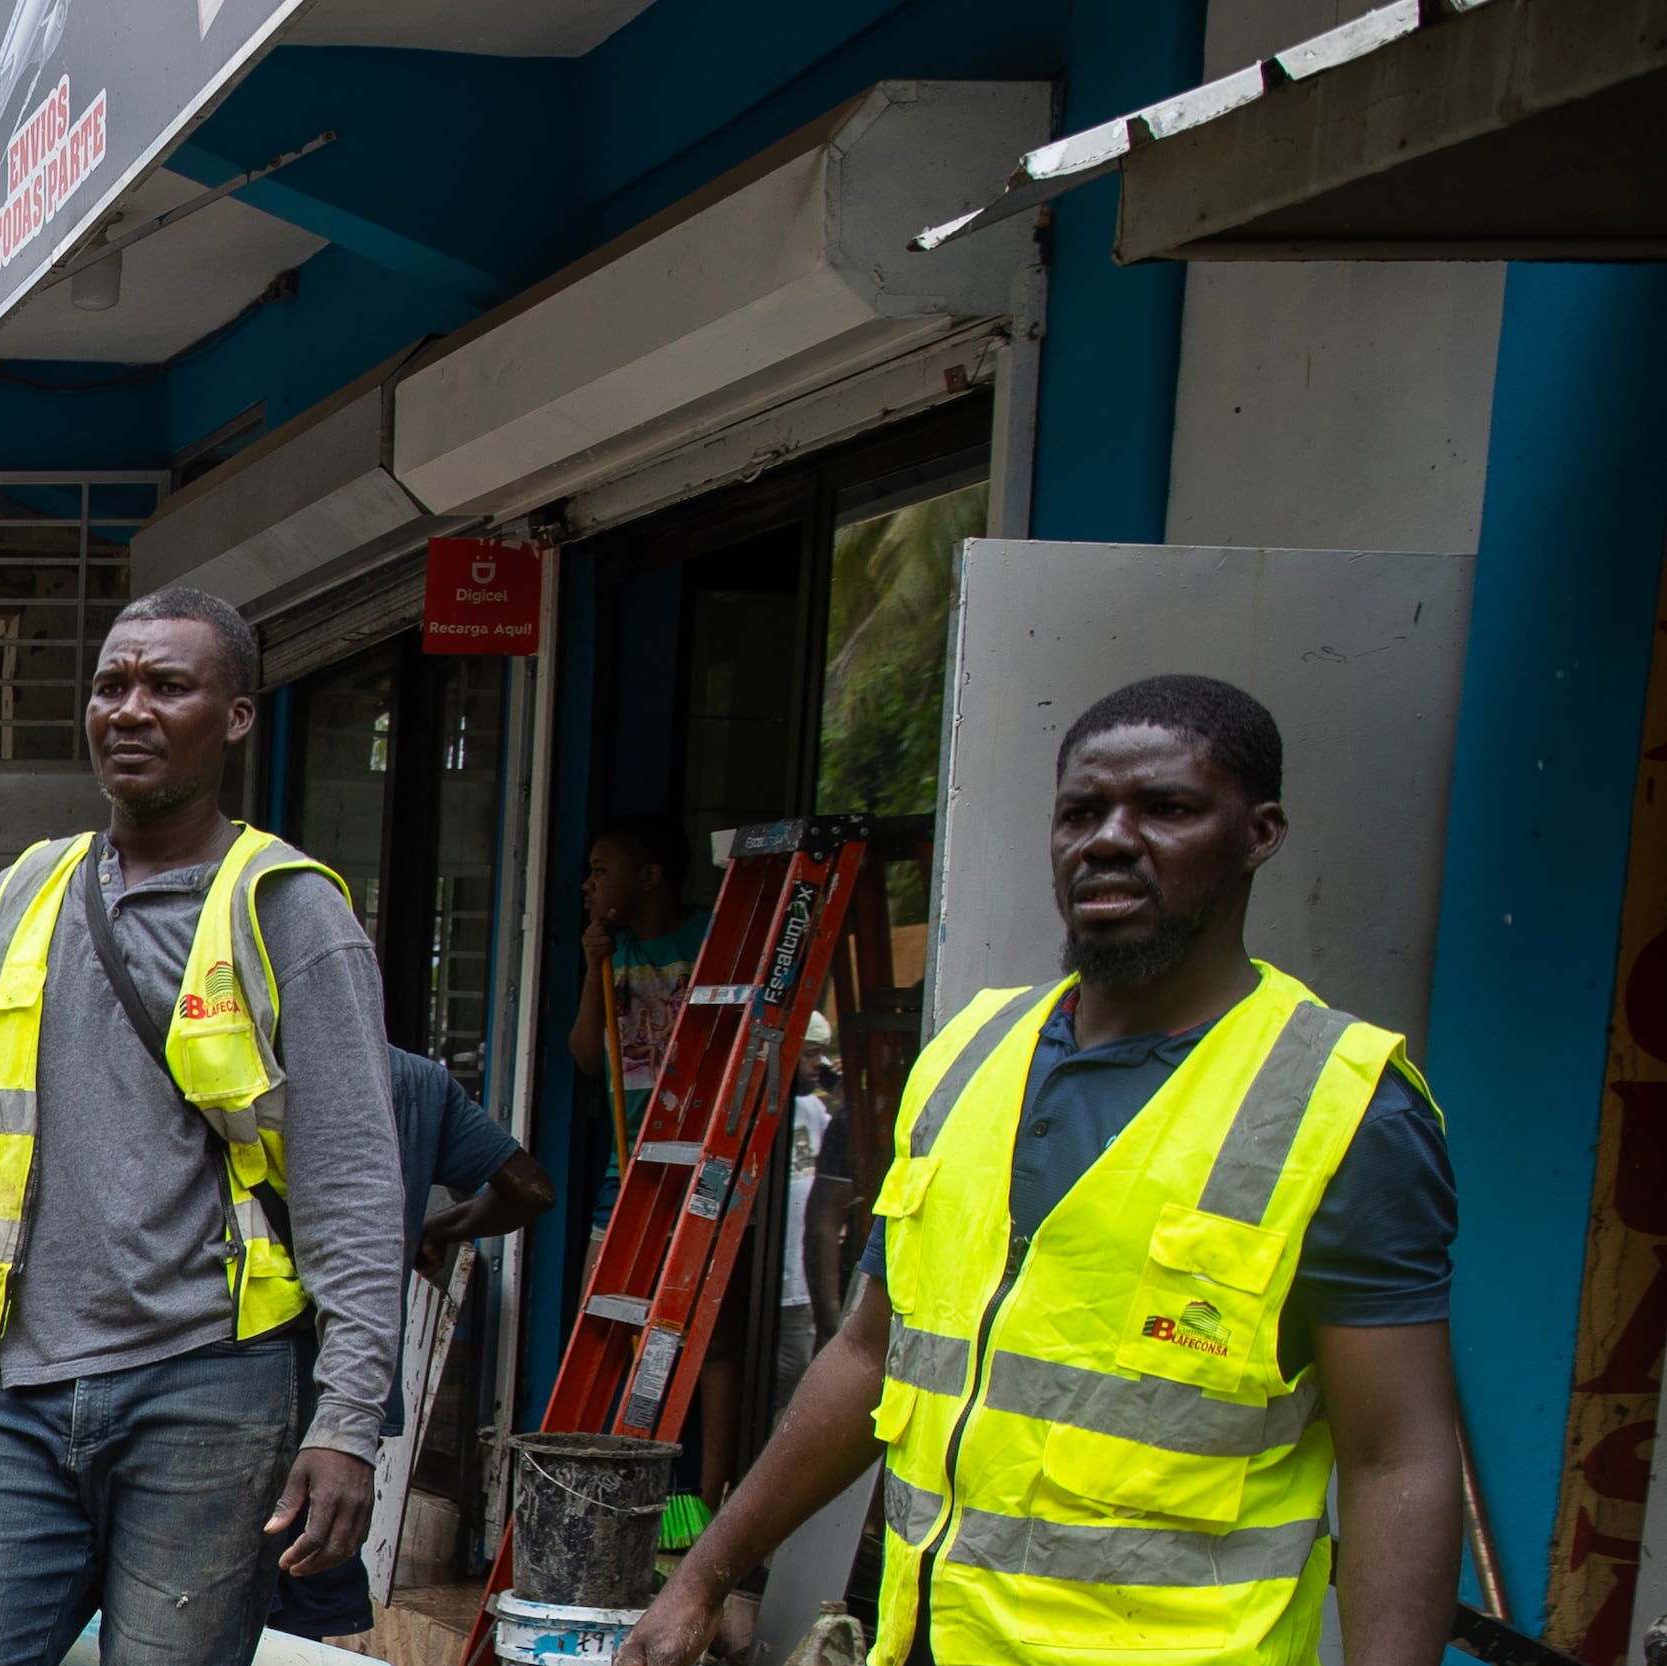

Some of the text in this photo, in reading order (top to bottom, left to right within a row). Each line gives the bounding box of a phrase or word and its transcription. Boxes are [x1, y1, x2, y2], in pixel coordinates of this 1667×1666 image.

[8, 74, 70, 200] ENVIOS
[44, 88, 106, 224] PARTE
[429, 622, 488, 637] Recarga
[456, 589, 508, 604] Digicel
